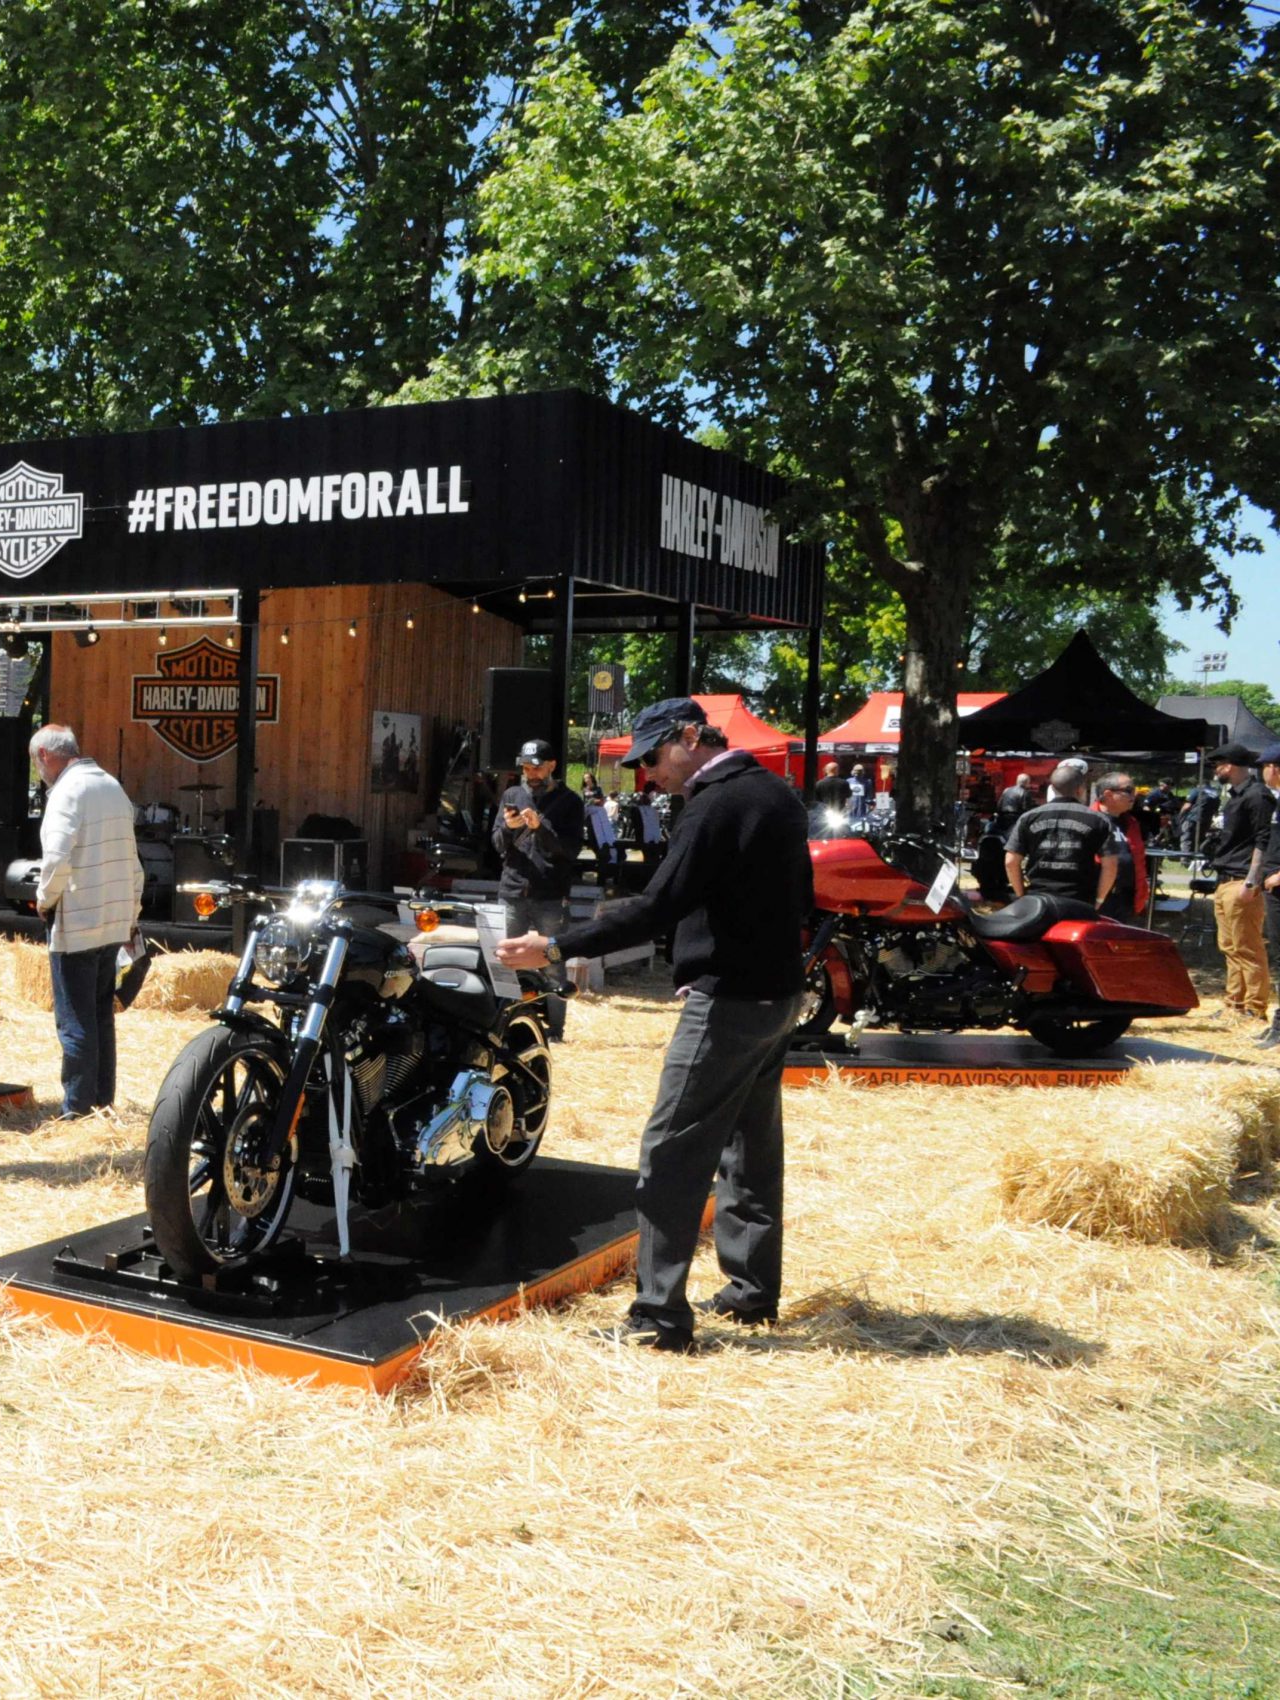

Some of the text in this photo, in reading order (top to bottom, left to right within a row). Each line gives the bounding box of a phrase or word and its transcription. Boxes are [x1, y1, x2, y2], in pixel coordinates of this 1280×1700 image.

[128, 465, 469, 533] #FREEDOMFORALL
[172, 650, 237, 678] MOTOR
[142, 685, 267, 712] HARLEY-DAVIDN
[170, 718, 236, 749] CYCLES
